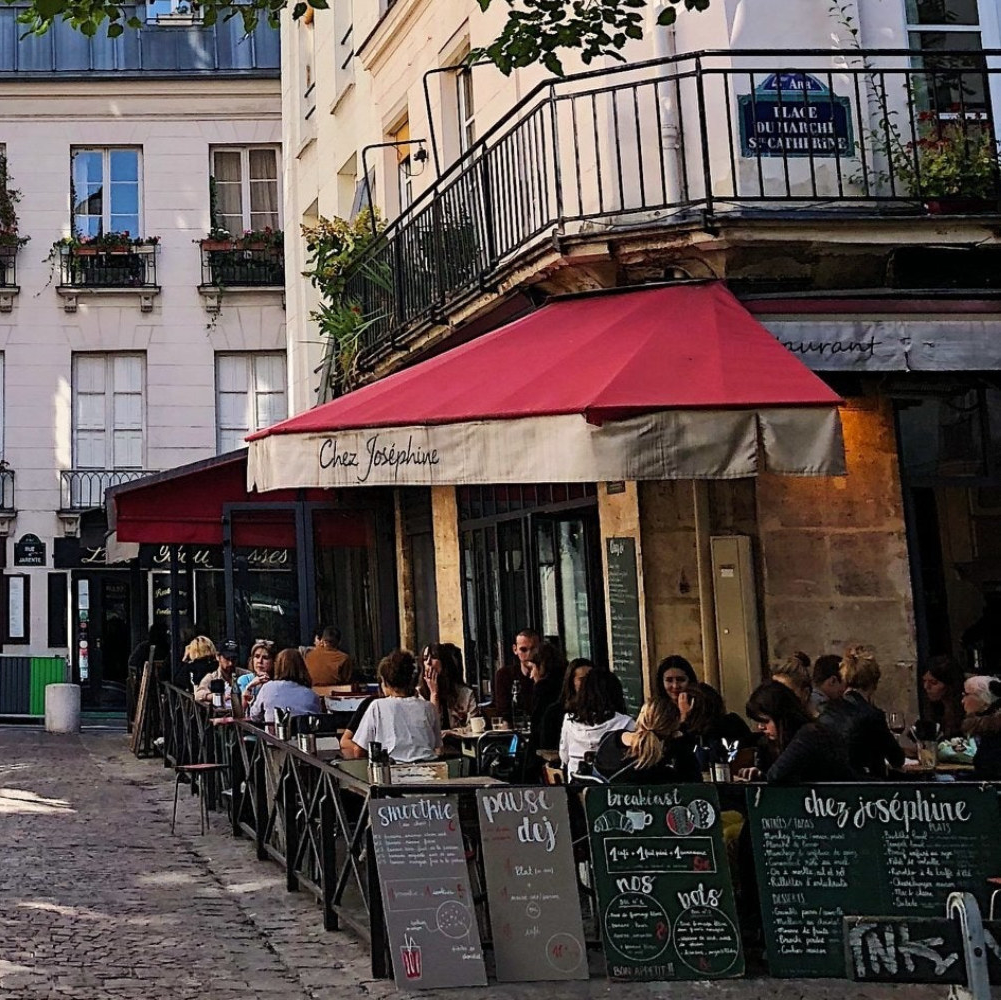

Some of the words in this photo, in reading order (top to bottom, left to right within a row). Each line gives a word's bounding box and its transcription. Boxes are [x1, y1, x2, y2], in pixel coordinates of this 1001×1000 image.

[320, 438, 359, 469] Chez
[357, 433, 440, 482] Joséphine
[378, 798, 455, 826] smoothie
[482, 788, 555, 823] pause
[607, 788, 682, 807] breakfast
[804, 789, 851, 828] chez
[854, 790, 971, 832] joséphine
